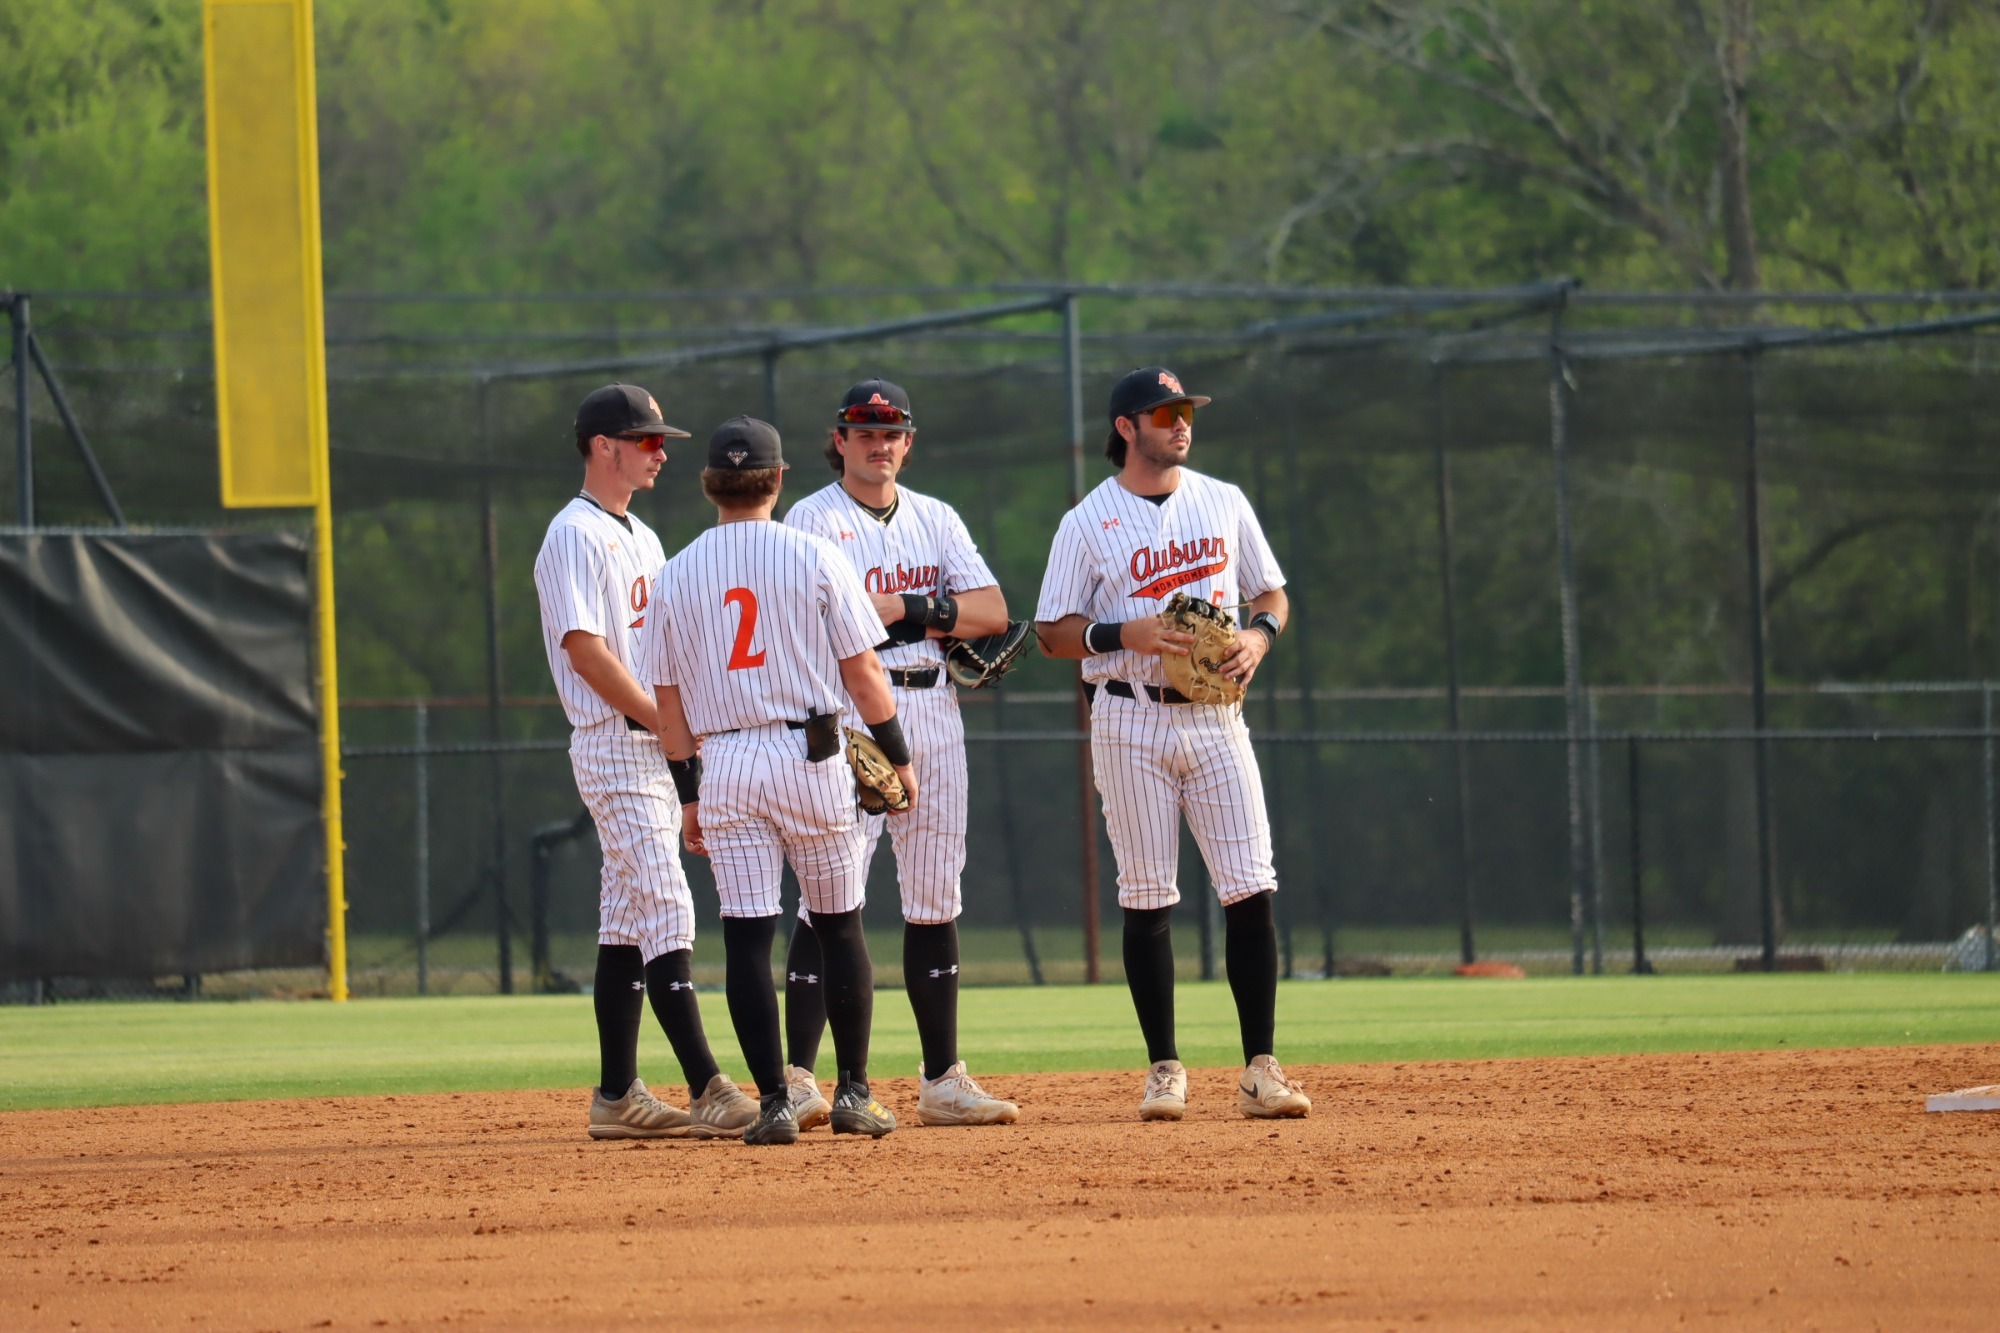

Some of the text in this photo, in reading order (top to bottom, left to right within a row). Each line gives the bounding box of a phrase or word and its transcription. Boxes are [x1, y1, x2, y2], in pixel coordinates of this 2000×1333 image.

[1131, 537, 1226, 581] Auburn
[1153, 566, 1216, 594] MONTGOMERY
[723, 587, 766, 671] 2
